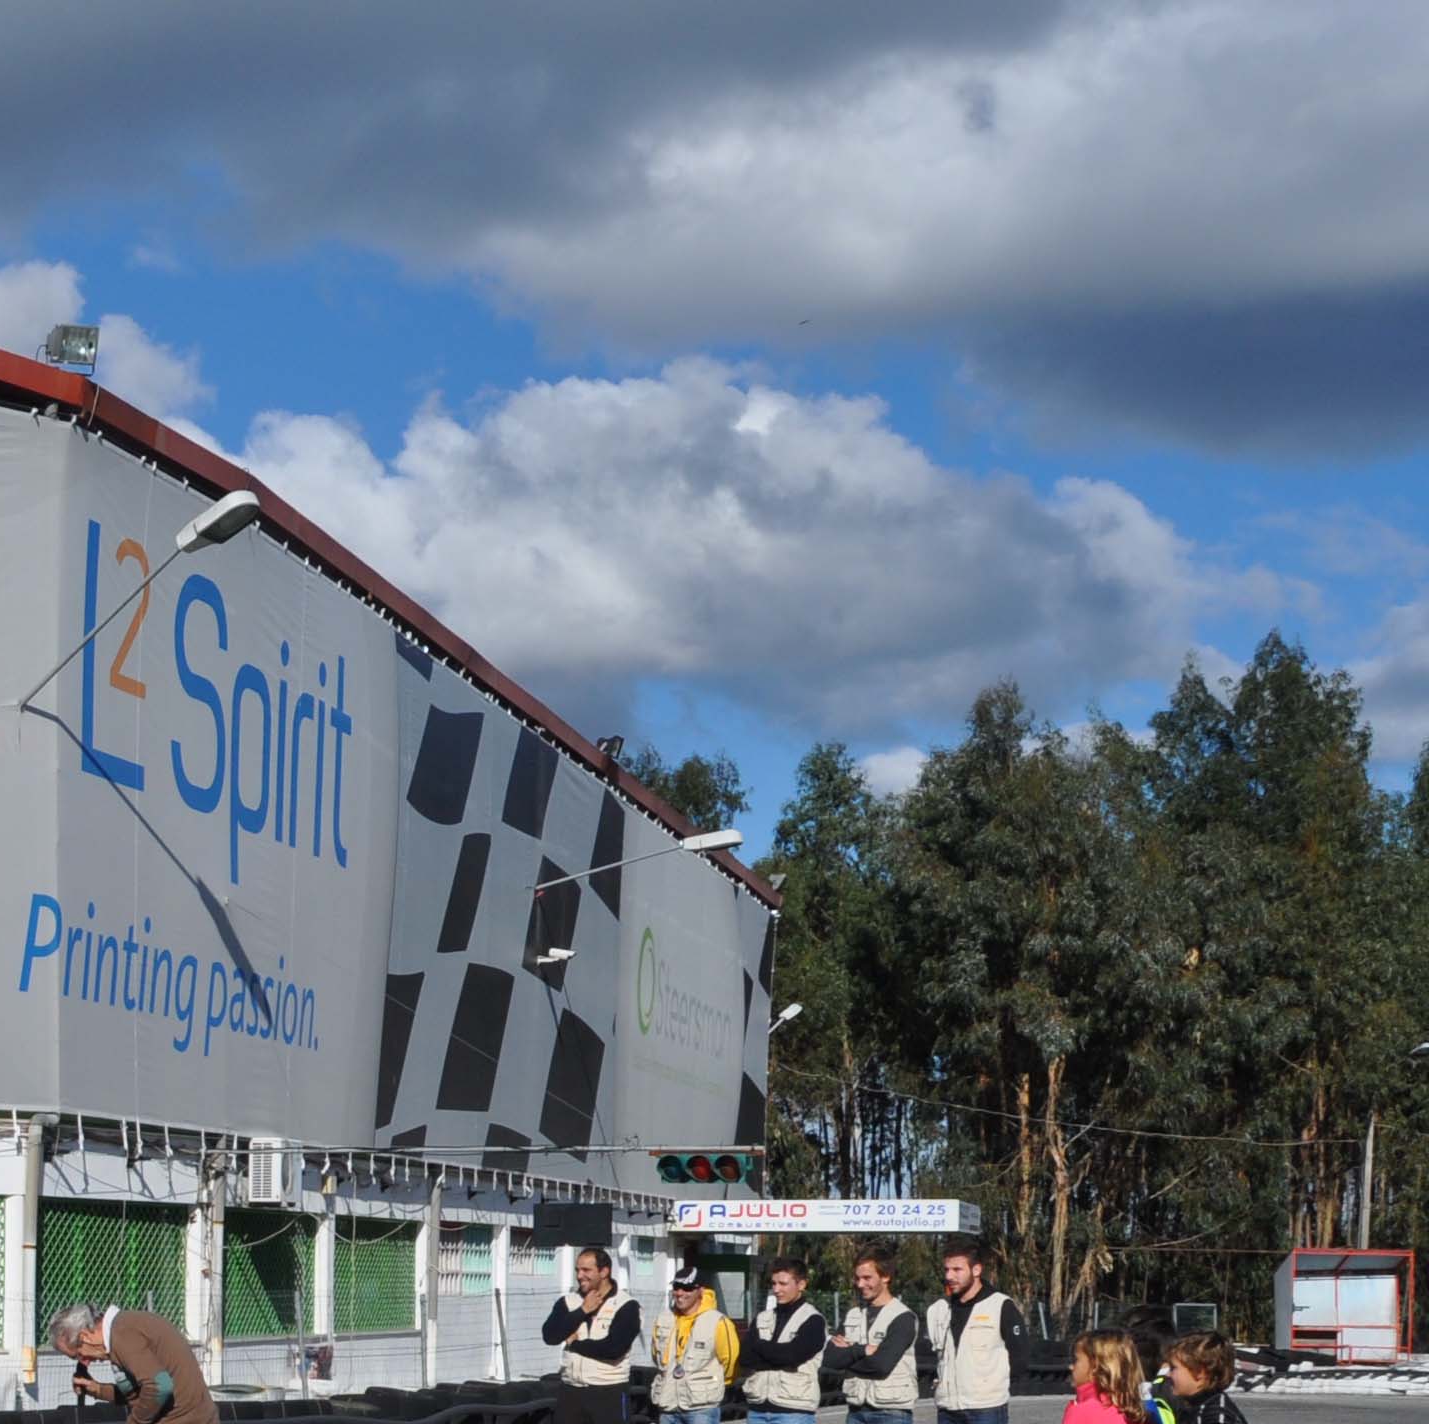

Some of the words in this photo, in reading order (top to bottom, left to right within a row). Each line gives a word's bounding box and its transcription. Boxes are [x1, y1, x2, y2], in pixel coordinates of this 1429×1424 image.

[171, 574, 352, 885] Spirit
[19, 894, 199, 1052] Printing
[204, 955, 319, 1056] passion.
[843, 1204, 871, 1215] 707
[877, 1204, 896, 1215] 20
[901, 1204, 921, 1215] 24
[927, 1204, 946, 1215] 25
